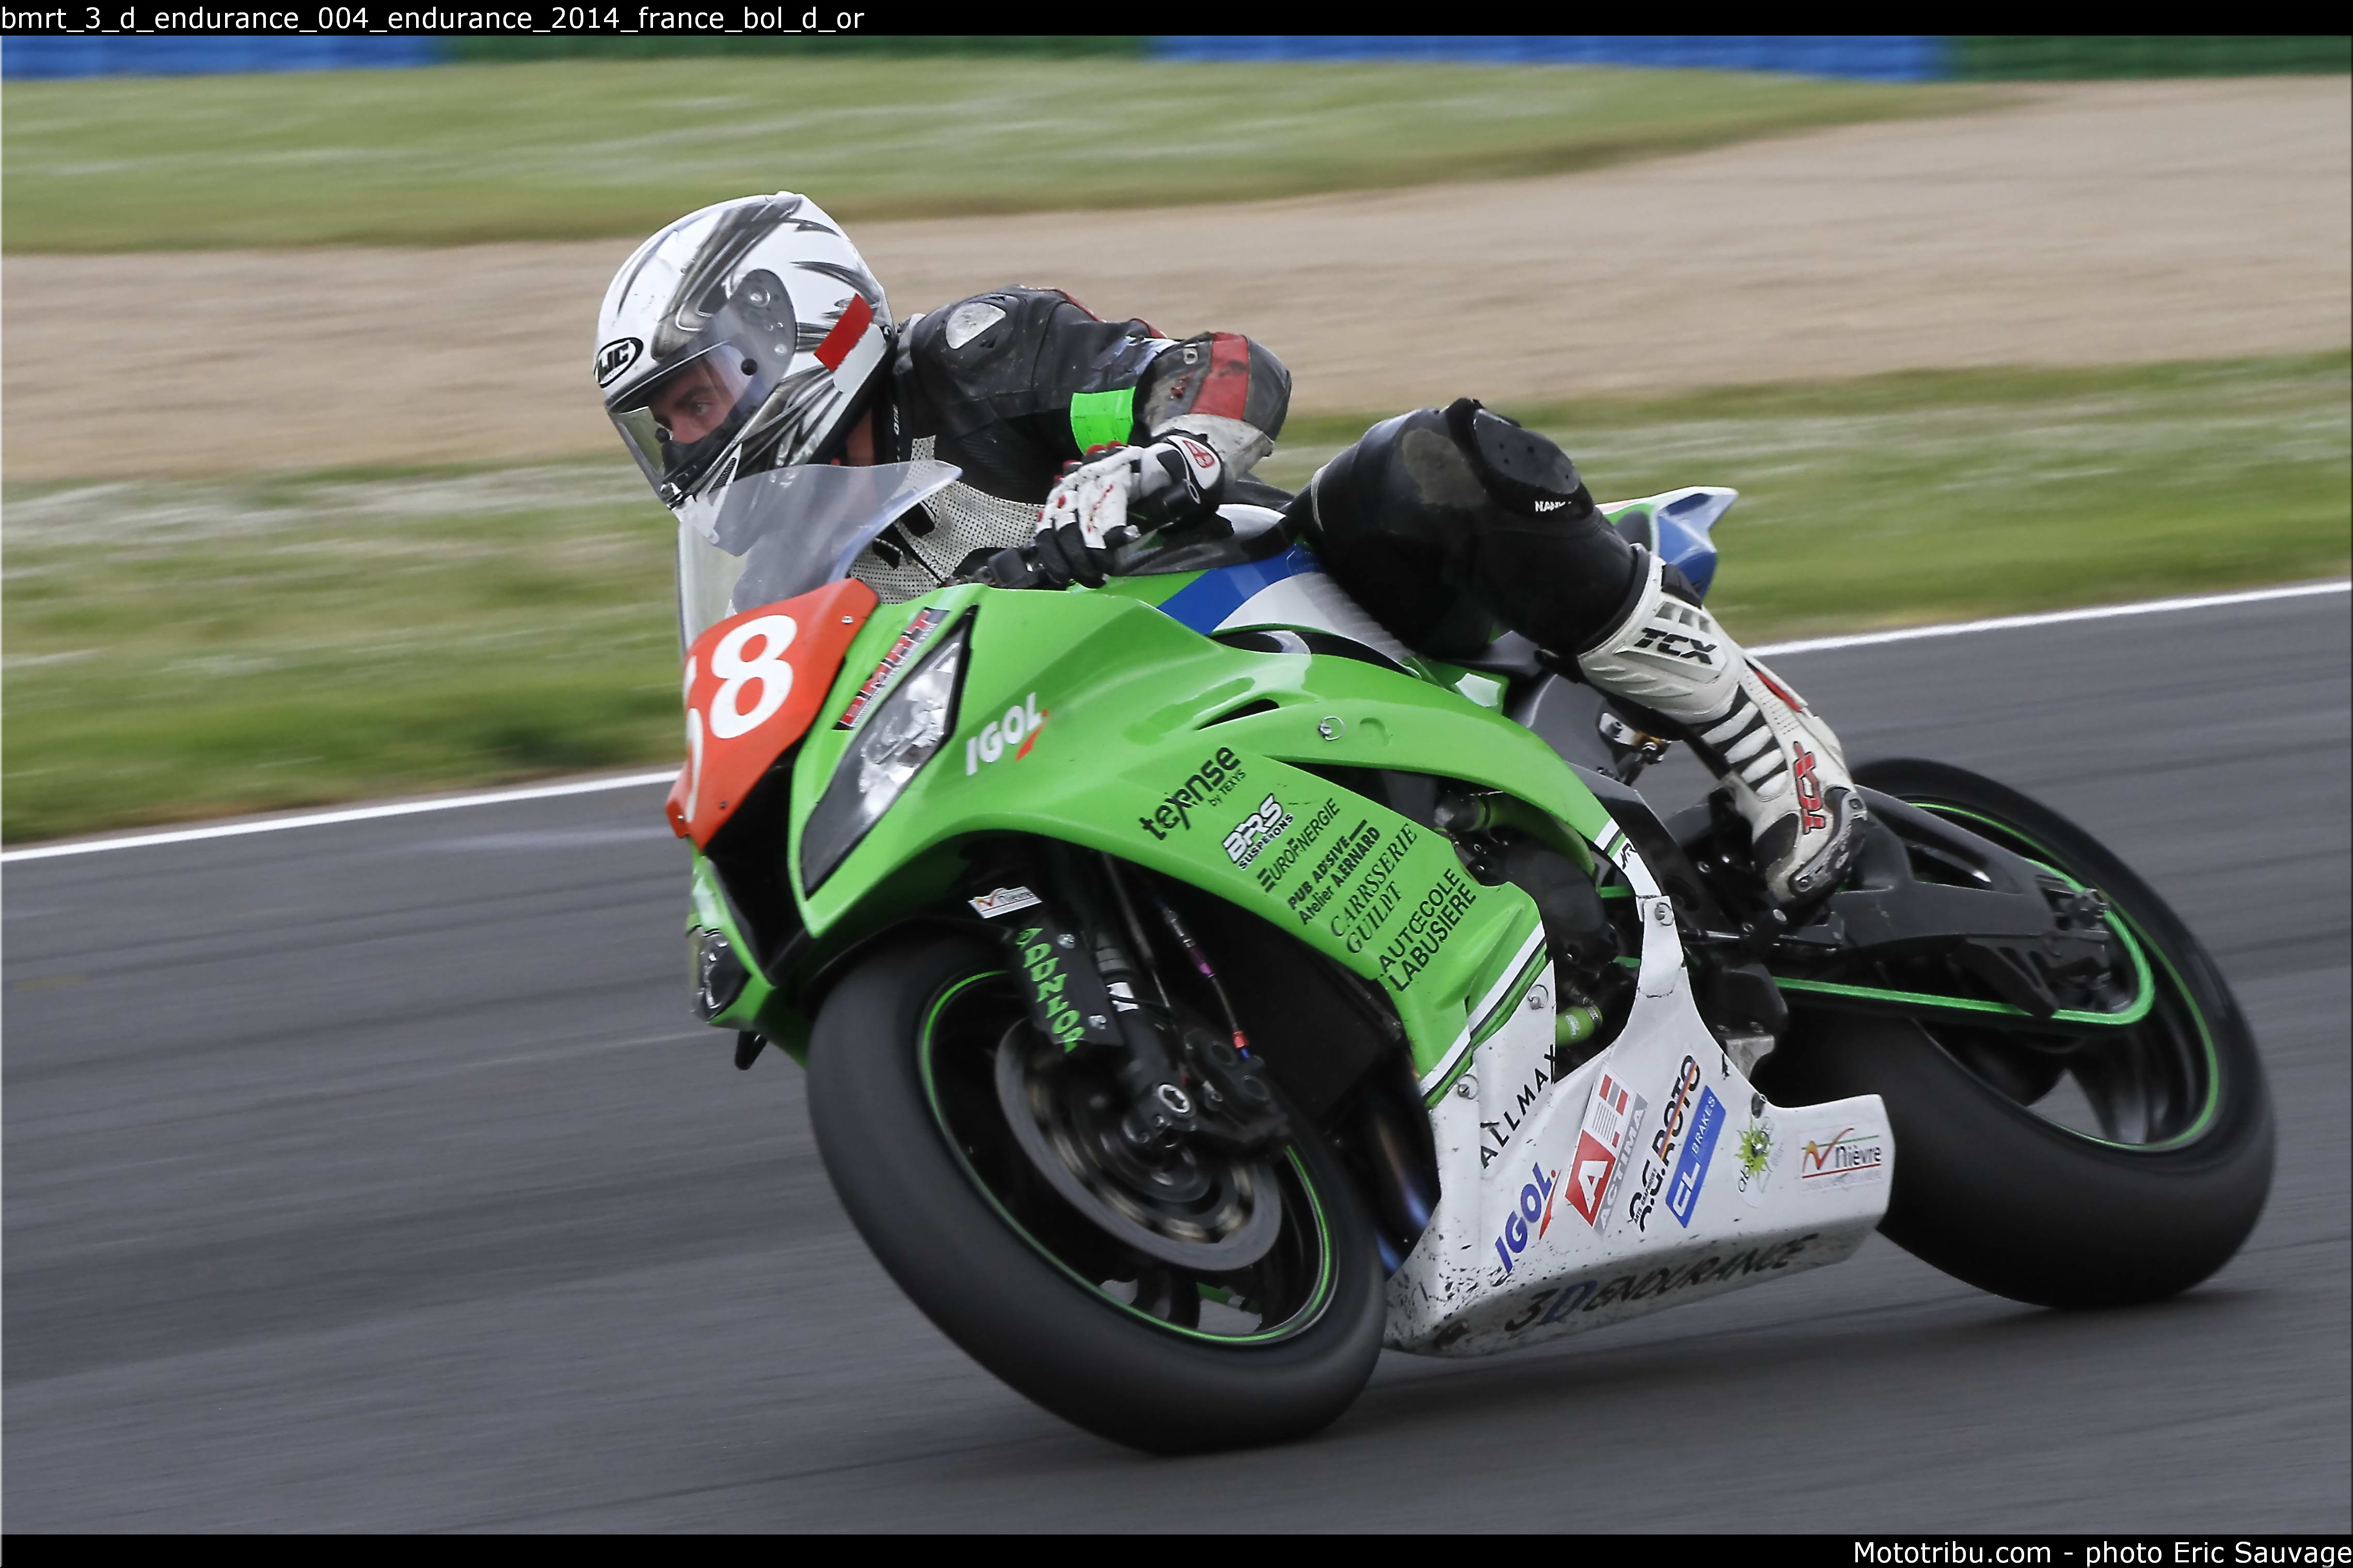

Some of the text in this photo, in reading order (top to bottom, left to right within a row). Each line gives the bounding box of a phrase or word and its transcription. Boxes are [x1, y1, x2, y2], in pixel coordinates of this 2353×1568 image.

[1633, 628, 1717, 665] TCX
[965, 692, 1044, 776] IGOL
[1287, 881, 1313, 910] PUB
[1299, 885, 1334, 925] Atelier
[1692, 1096, 1716, 1155] BRAKES
[1600, 1109, 1645, 1229] ACTIMA
[1495, 1161, 1553, 1274] IGOL
